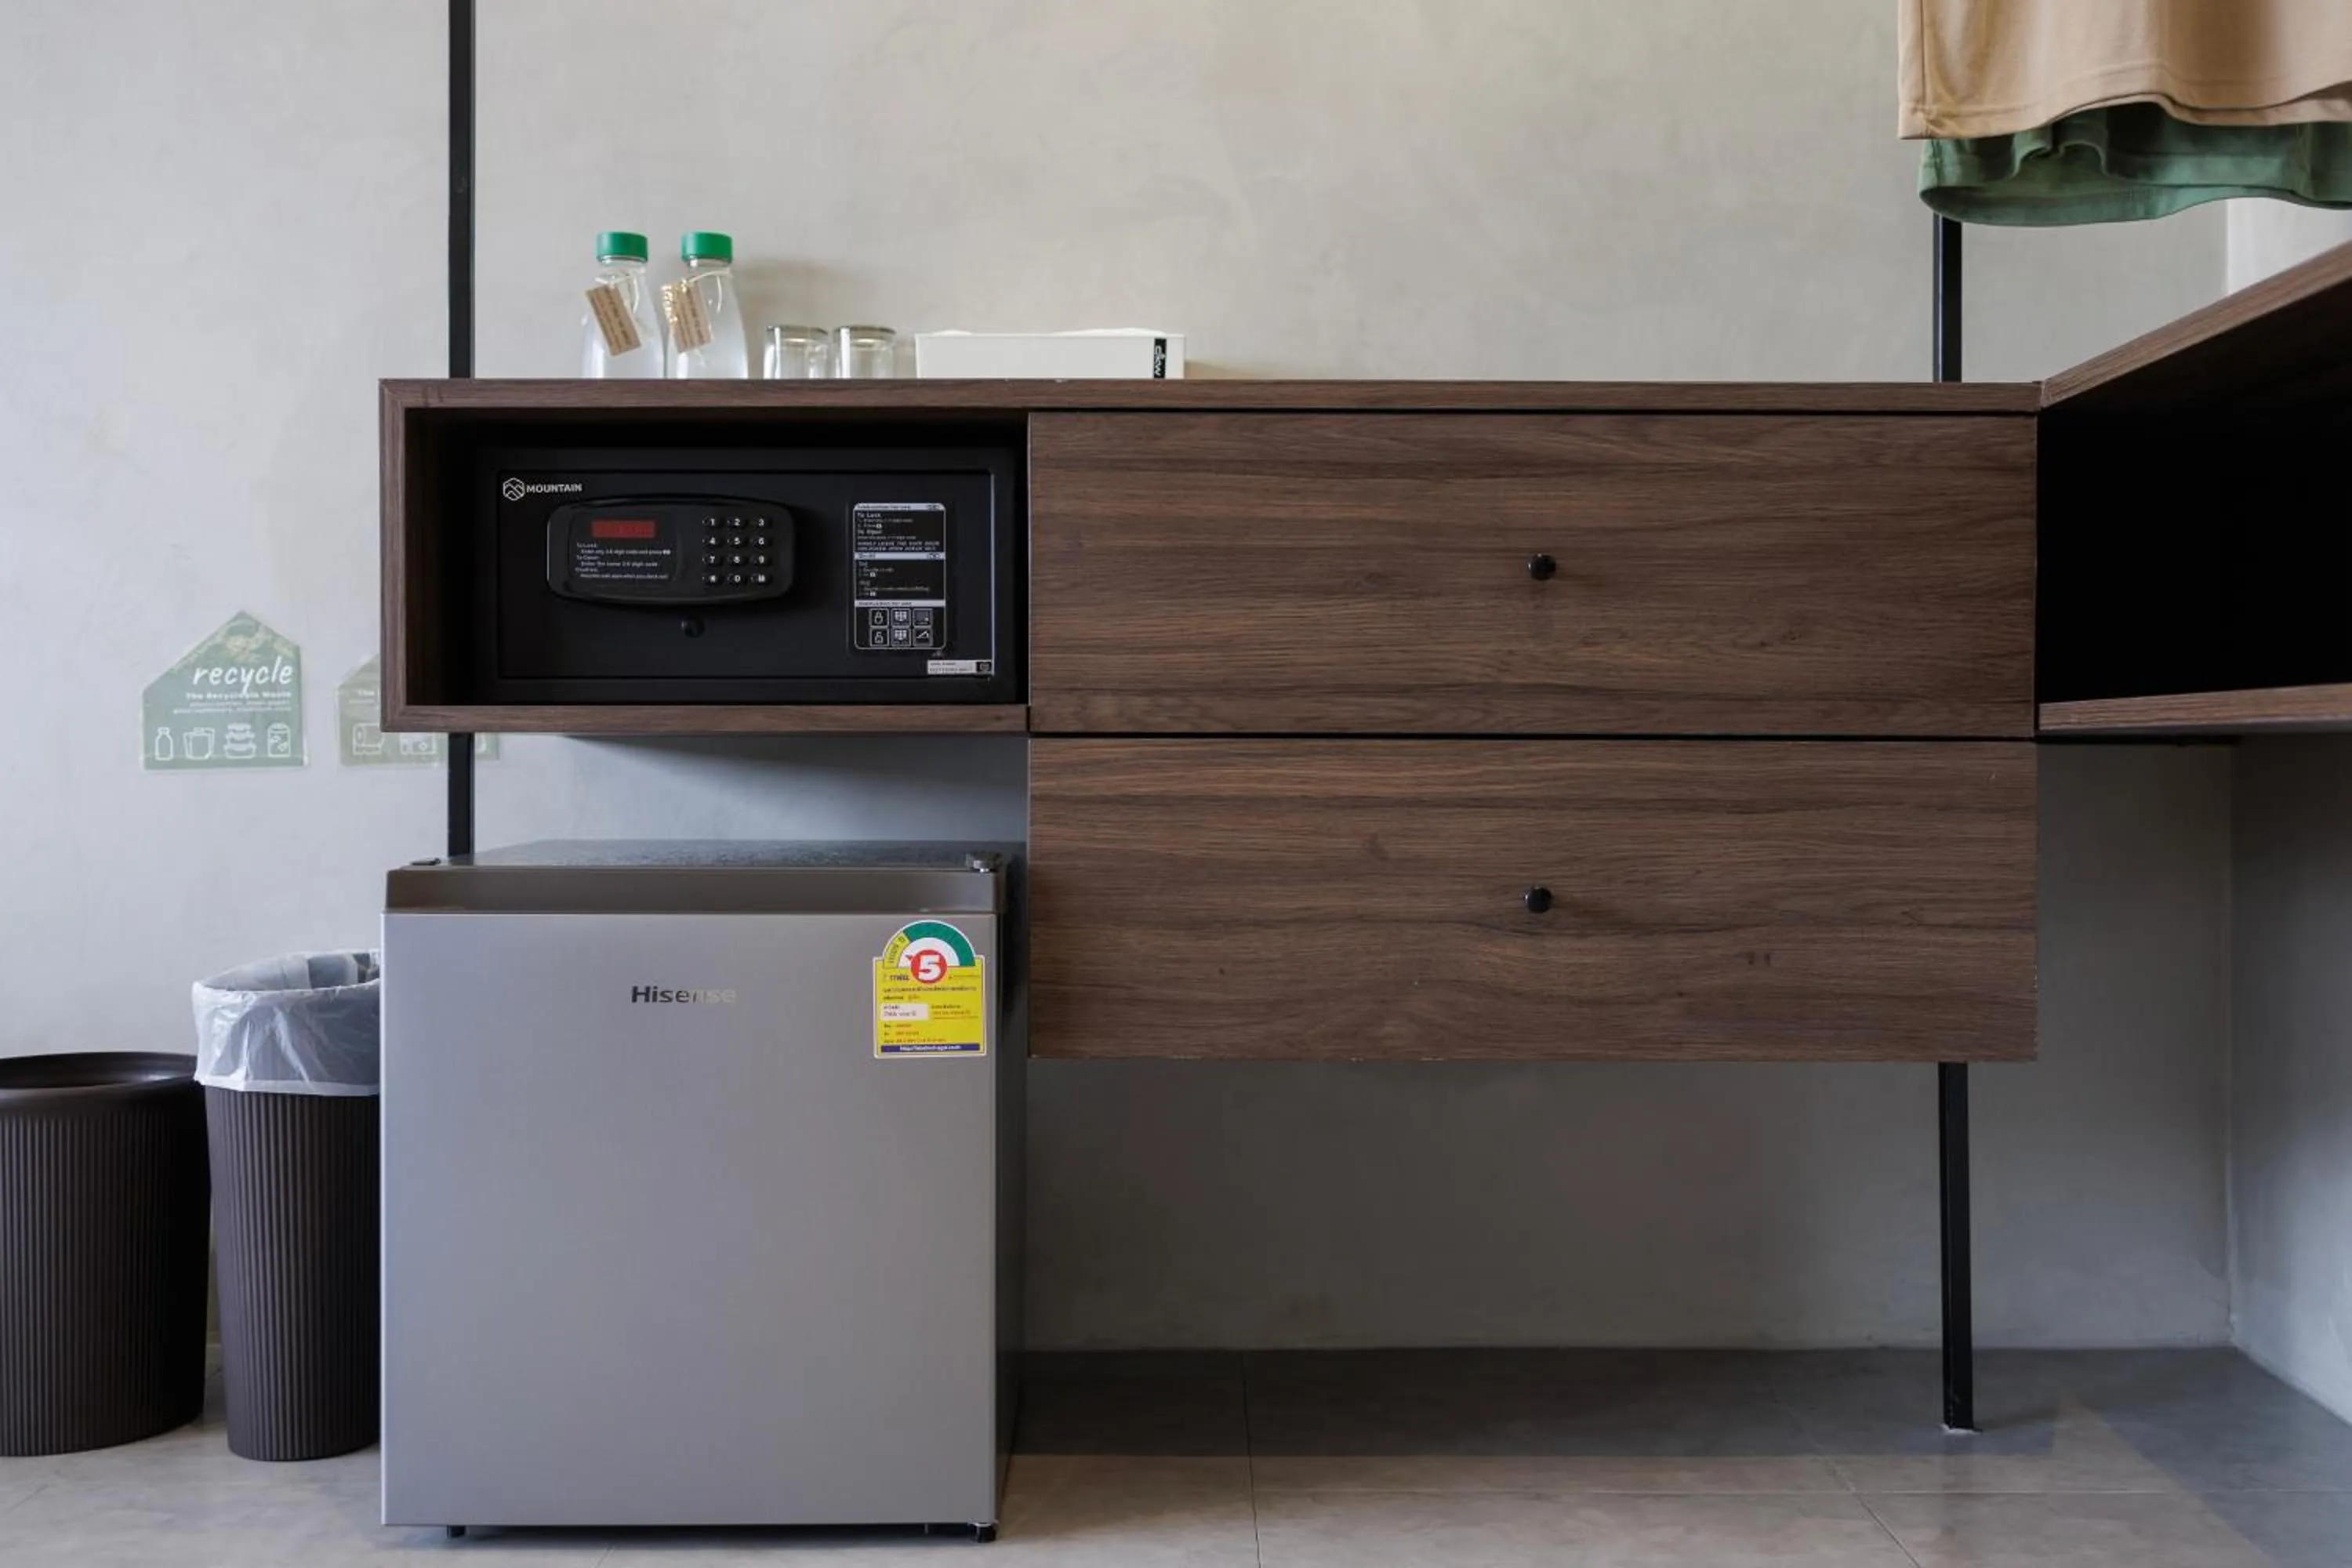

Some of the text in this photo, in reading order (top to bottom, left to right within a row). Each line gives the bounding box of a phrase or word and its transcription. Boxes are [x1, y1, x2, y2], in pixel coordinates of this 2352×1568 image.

[526, 483, 583, 493] MOUNTAIN
[710, 517, 765, 527] 1 2 3
[709, 536, 765, 545] 4 5 6
[709, 555, 765, 564] 7 8 9
[734, 574, 741, 583] 0
[192, 655, 293, 696] recycle
[918, 954, 942, 981] 5
